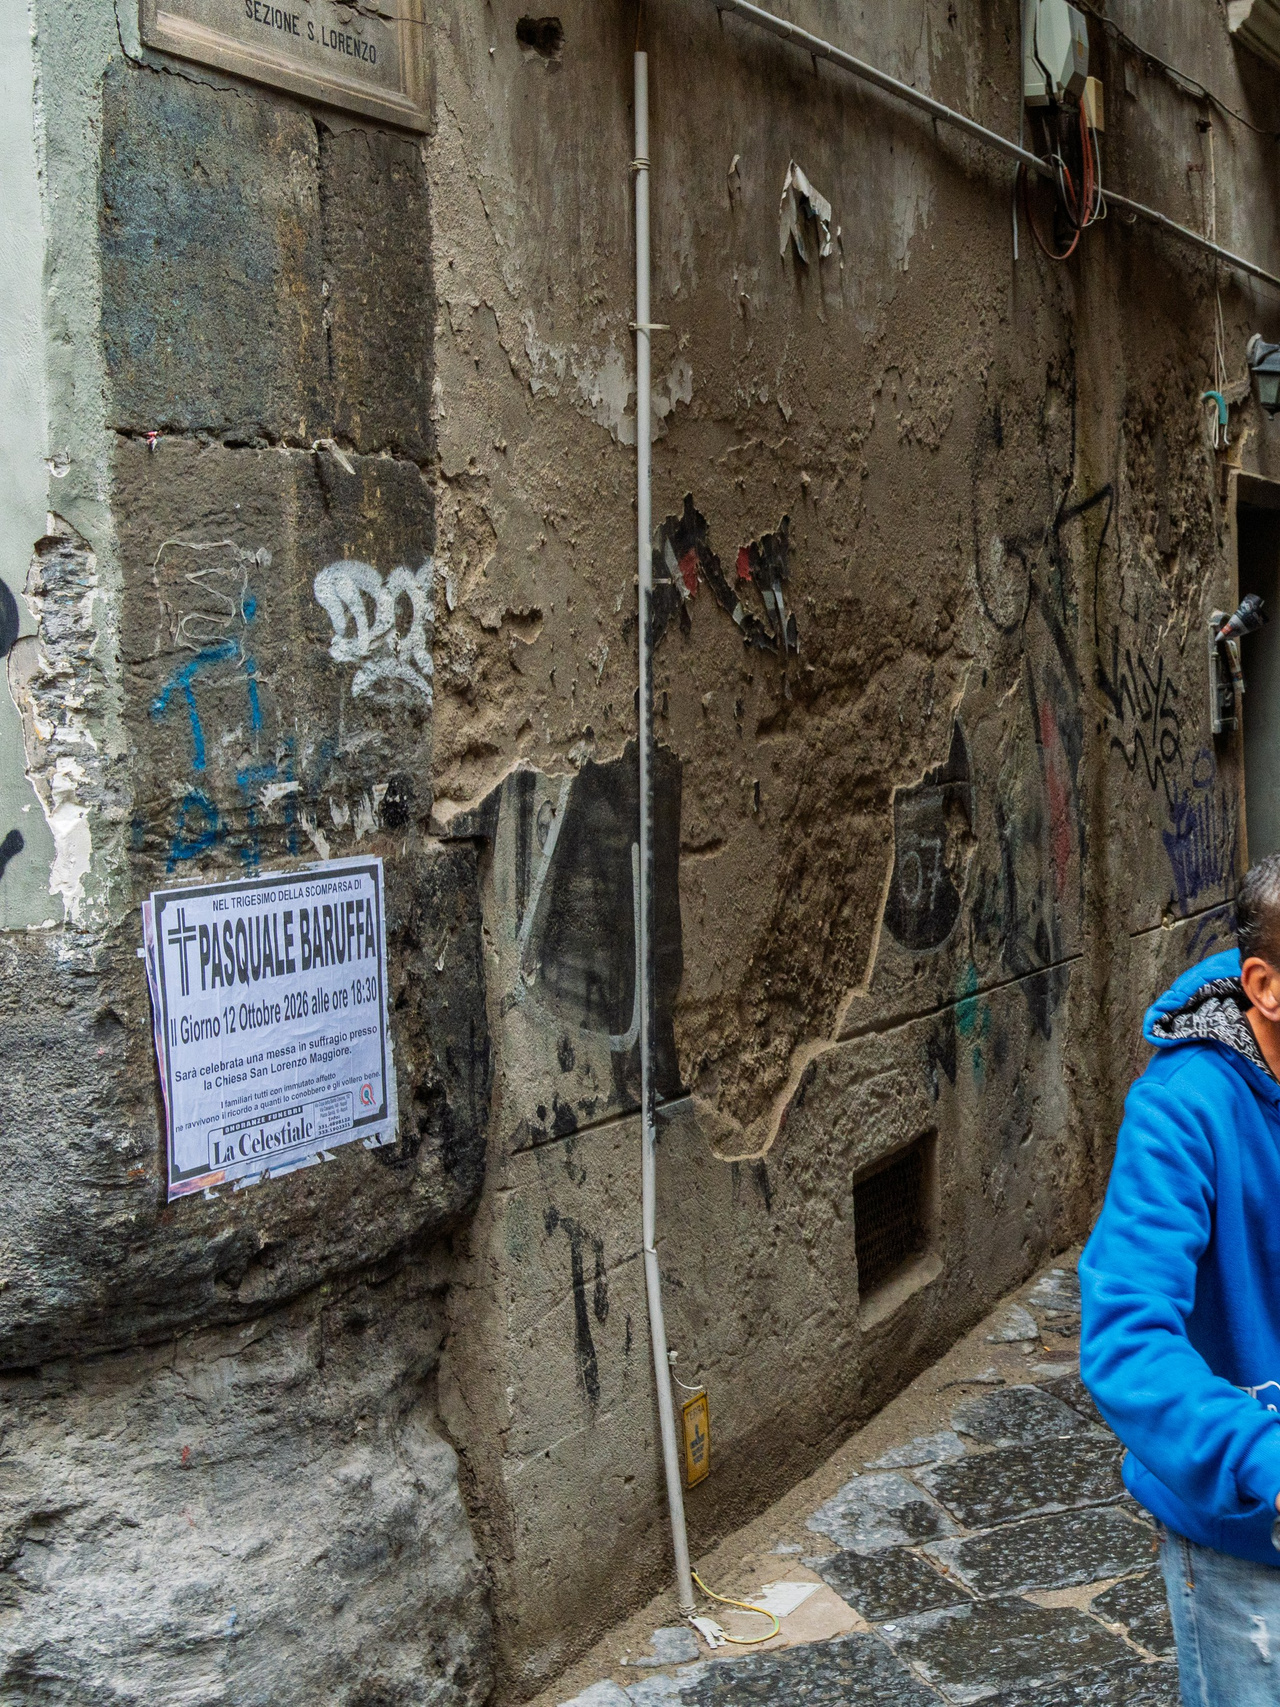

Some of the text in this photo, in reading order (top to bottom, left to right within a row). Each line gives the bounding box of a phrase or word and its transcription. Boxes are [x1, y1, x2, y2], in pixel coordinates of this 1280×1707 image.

[245, 0, 377, 64] SEZIONE S. LORENZO
[213, 879, 362, 912] NEL TRIGESIMO DELLA SCOMPARSA DI
[198, 898, 376, 990] PASQUALE BARUFFA
[170, 976, 377, 1047] Il Giorno 12 Ottobre 2026 alle ore 18:30
[175, 1025, 378, 1082] Sarà celebrata una messa in suffragio presso
[204, 1046, 352, 1091] la Chiesa San Lorenzo Maggiore.
[175, 1125, 183, 1133] ne
[185, 1115, 220, 1130] ravvivono
[221, 1112, 226, 1120] il
[227, 1105, 253, 1118] ricordo
[260, 1096, 282, 1110] quanti
[283, 1095, 290, 1103] lo
[291, 1087, 326, 1101] conobbero
[332, 1081, 340, 1091] gli
[341, 1075, 362, 1087] vollero
[224, 1093, 253, 1108] familiari
[254, 1089, 268, 1099] tutti
[269, 1086, 283, 1096] con
[283, 1078, 315, 1092] immutato
[316, 1072, 336, 1083] affetto
[213, 1117, 313, 1165] La Celestiale
